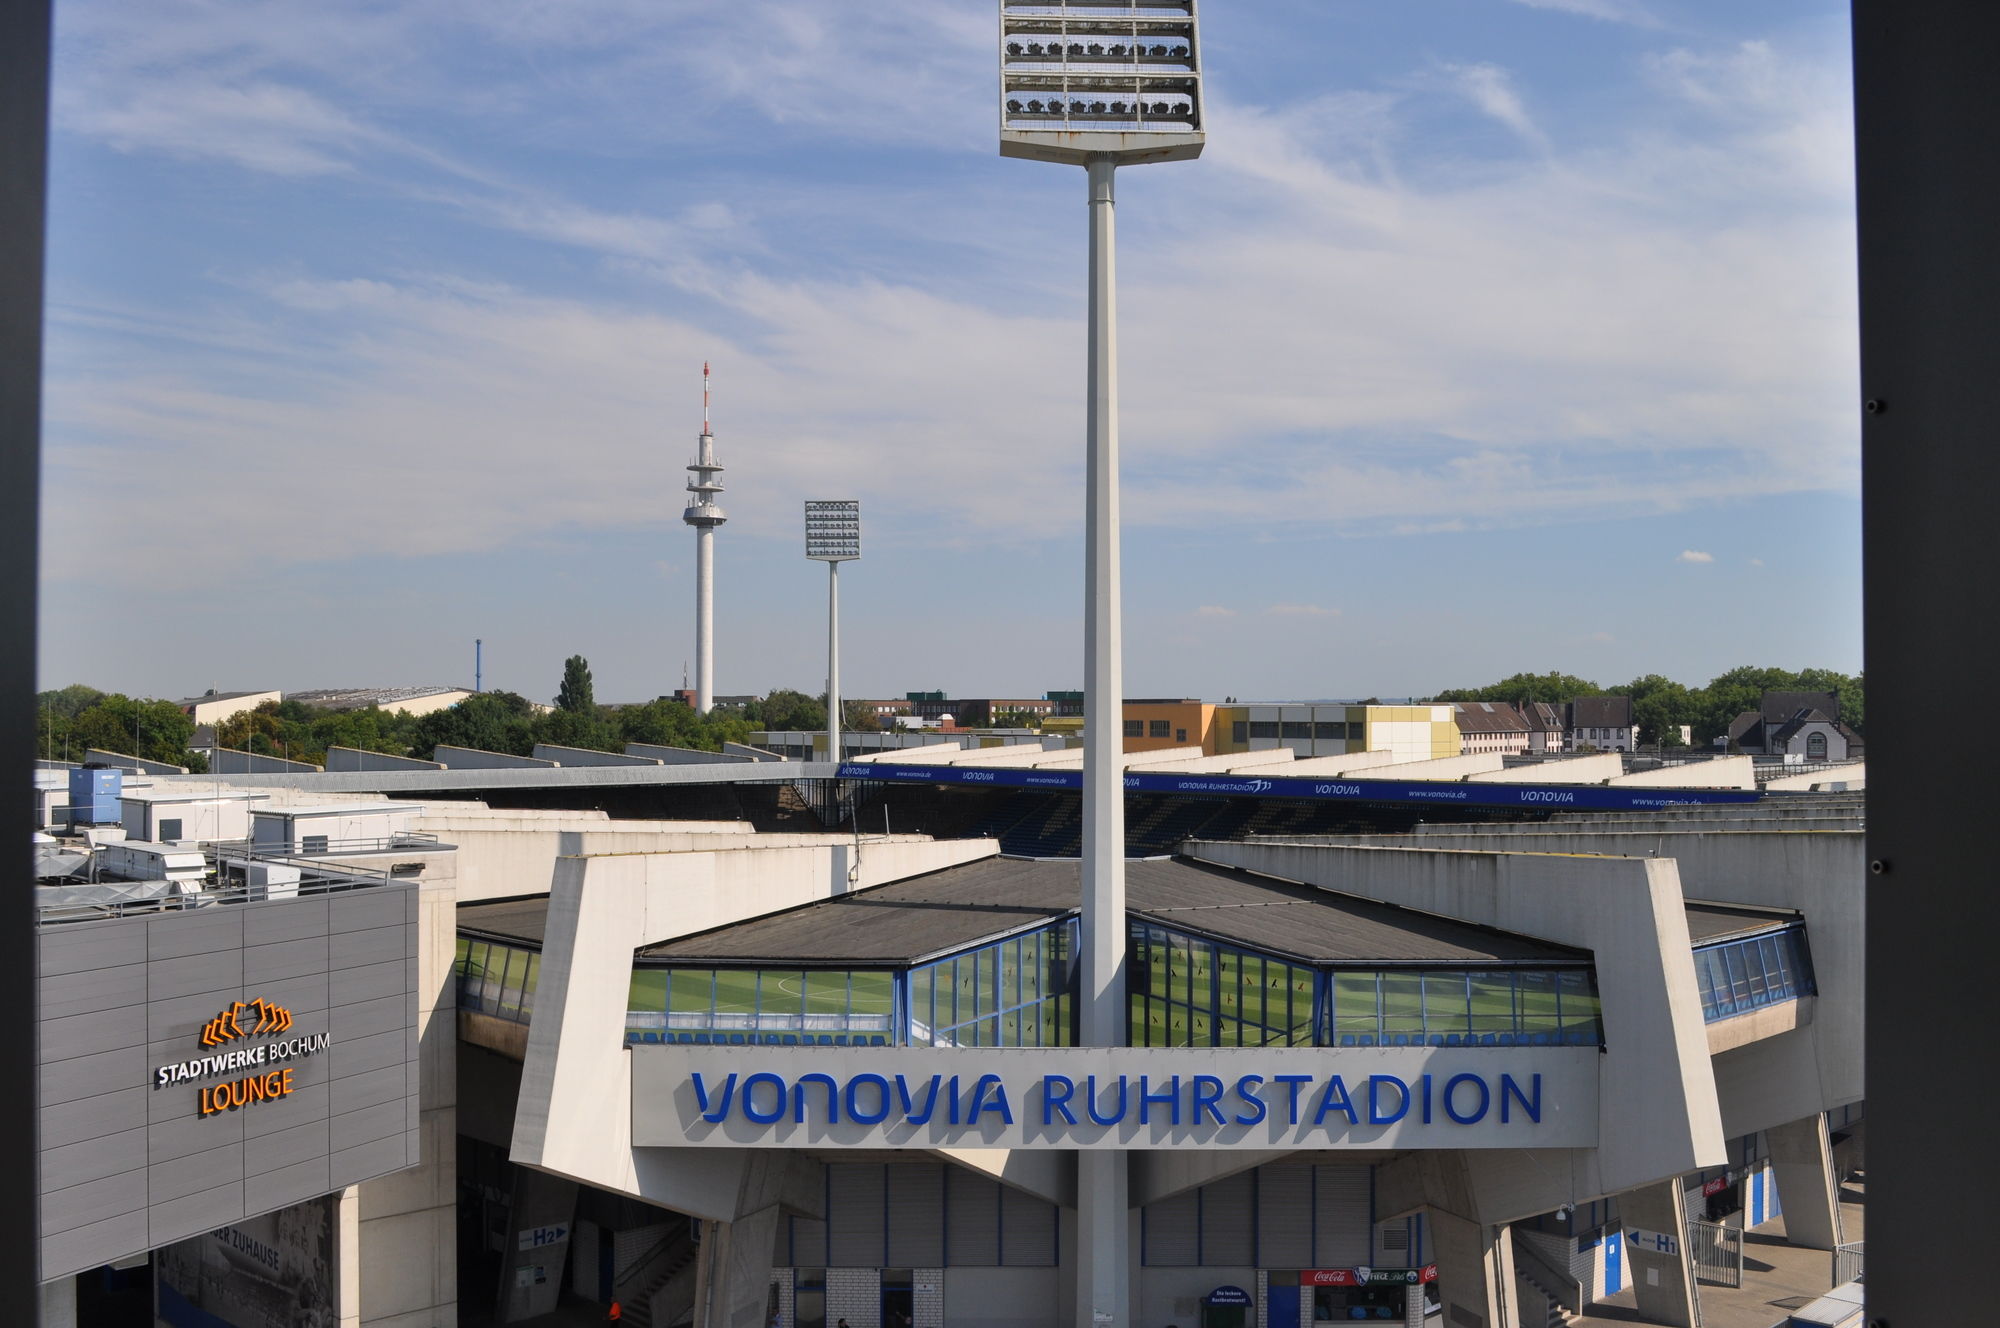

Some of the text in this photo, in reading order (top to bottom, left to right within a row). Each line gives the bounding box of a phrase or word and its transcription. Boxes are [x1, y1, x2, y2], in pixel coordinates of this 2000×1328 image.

[962, 771, 994, 781] VONOVIA
[1026, 777, 1067, 785] www.vonovia.de
[1208, 783, 1256, 792] RUHRSTADION
[1315, 784, 1360, 795] VONOVIA
[1408, 789, 1467, 799] www.vonovia.de
[1521, 791, 1574, 803] VONOVIA
[159, 1032, 330, 1085] STADTWERKE BOCHUM
[202, 1068, 294, 1114] LOUNGE
[691, 1072, 1542, 1126] VONOVIA RUHRSTADION
[534, 1228, 555, 1246] H2
[1657, 1234, 1676, 1254] H1
[232, 1229, 279, 1271] ZUHAUSE
